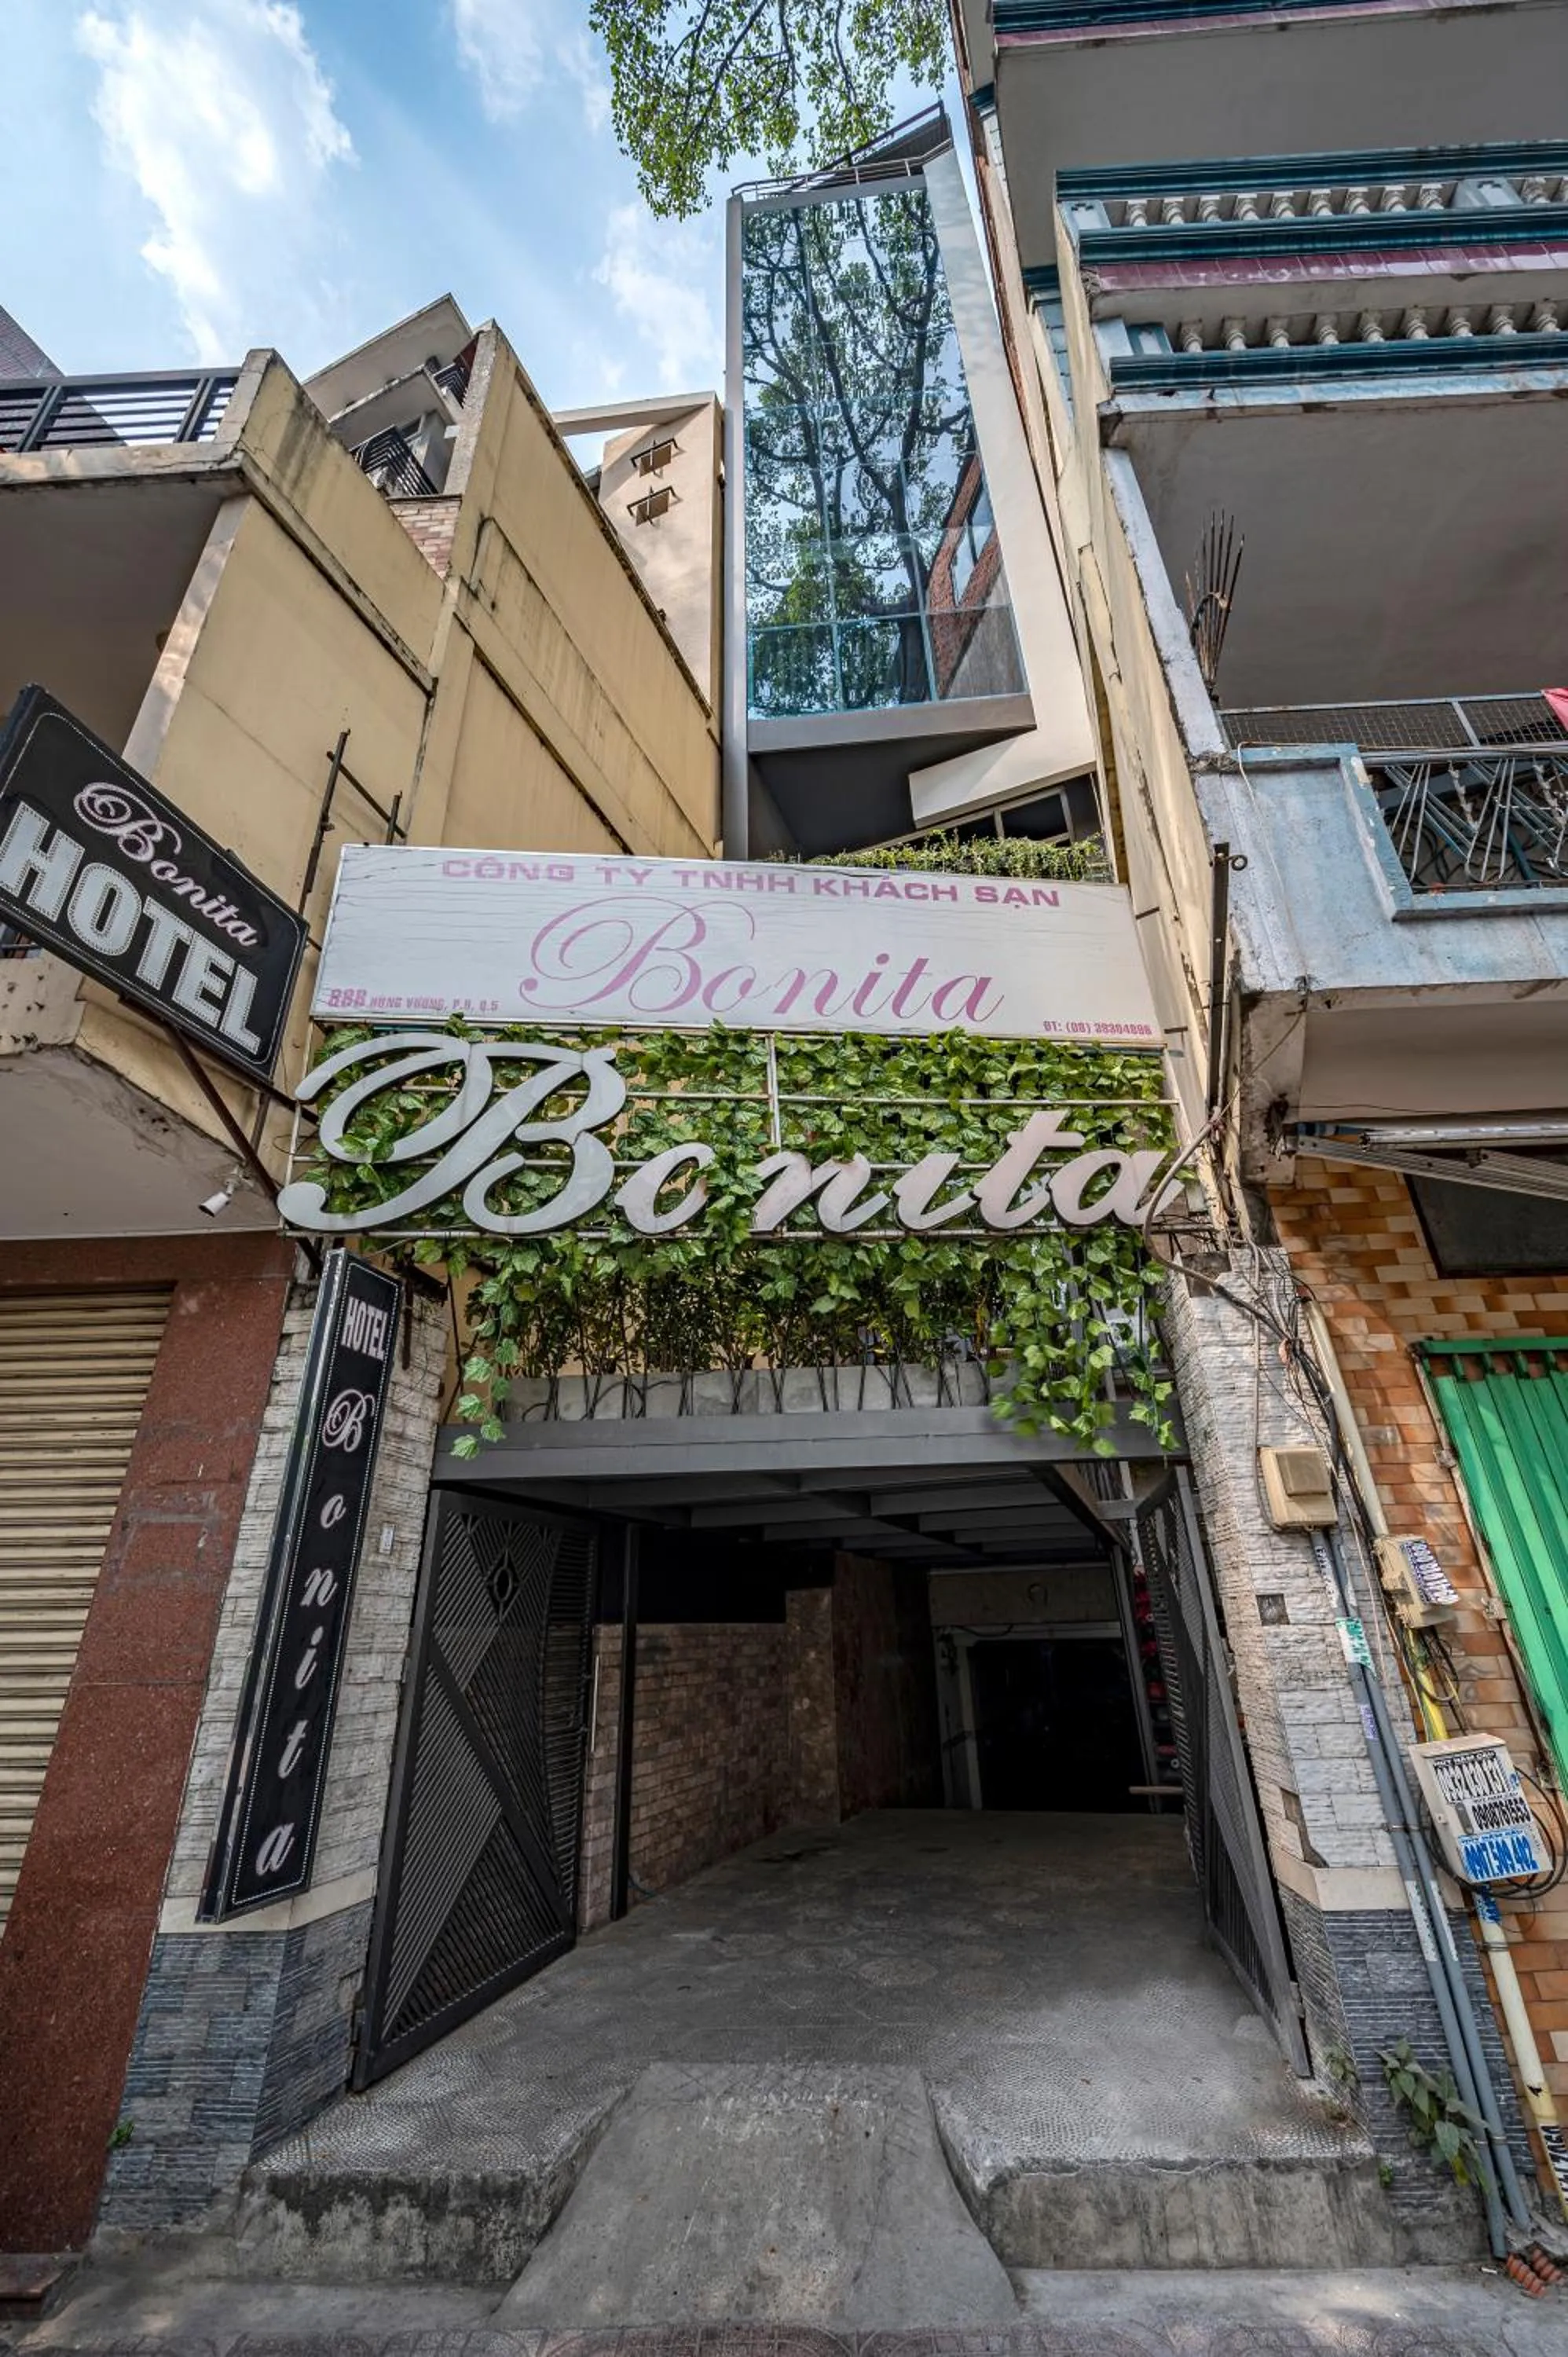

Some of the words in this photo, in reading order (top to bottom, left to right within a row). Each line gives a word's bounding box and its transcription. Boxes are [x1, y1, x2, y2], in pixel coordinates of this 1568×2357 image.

[0, 801, 262, 1056] HOTEL
[73, 780, 259, 948] Bonita
[442, 856, 574, 882] CÔNG
[595, 865, 654, 885] TY
[672, 869, 797, 894] TNHH
[813, 874, 957, 901] KHÁCH
[974, 885, 1060, 908] SẠN
[519, 896, 1005, 1021] Bonita
[277, 1032, 1185, 1235] Bonita
[341, 1296, 389, 1362] HOTEL
[255, 1388, 376, 1876] Bonita
